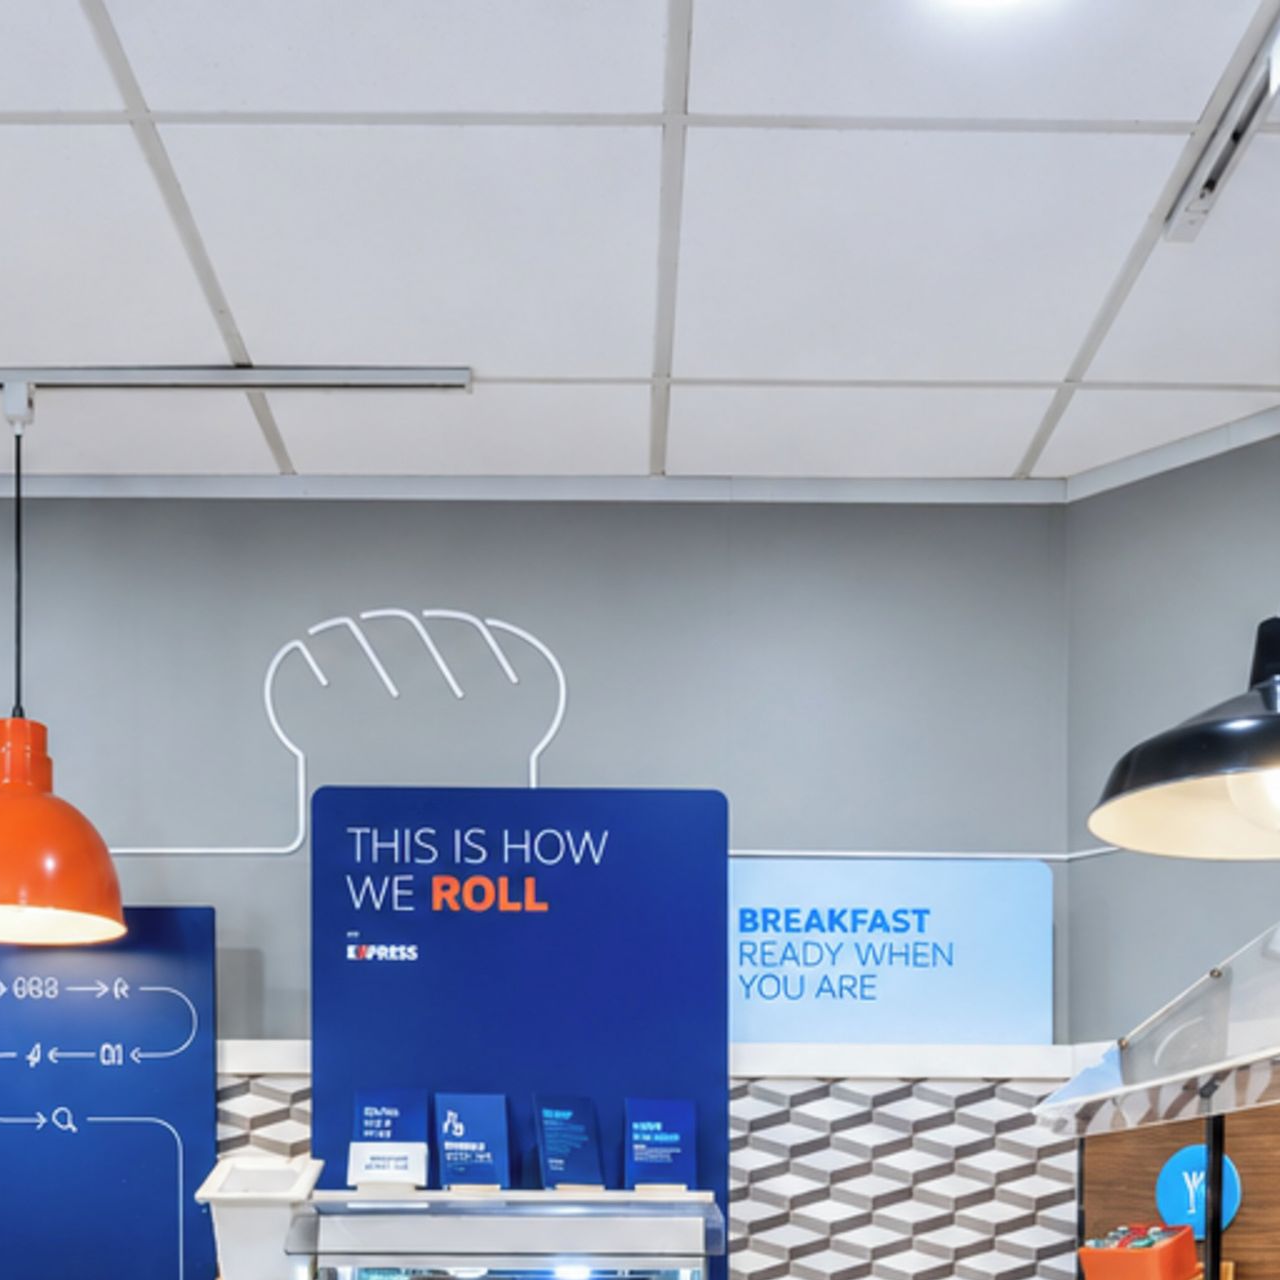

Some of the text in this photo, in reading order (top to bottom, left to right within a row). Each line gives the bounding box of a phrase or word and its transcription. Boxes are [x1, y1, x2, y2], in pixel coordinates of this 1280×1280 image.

[346, 827, 609, 865] THIS IS HOW
[346, 875, 549, 912] WE ROLL
[738, 908, 931, 933] BREAKFAST
[739, 941, 955, 967] READY WHEN
[739, 974, 878, 1000] YOU ARE
